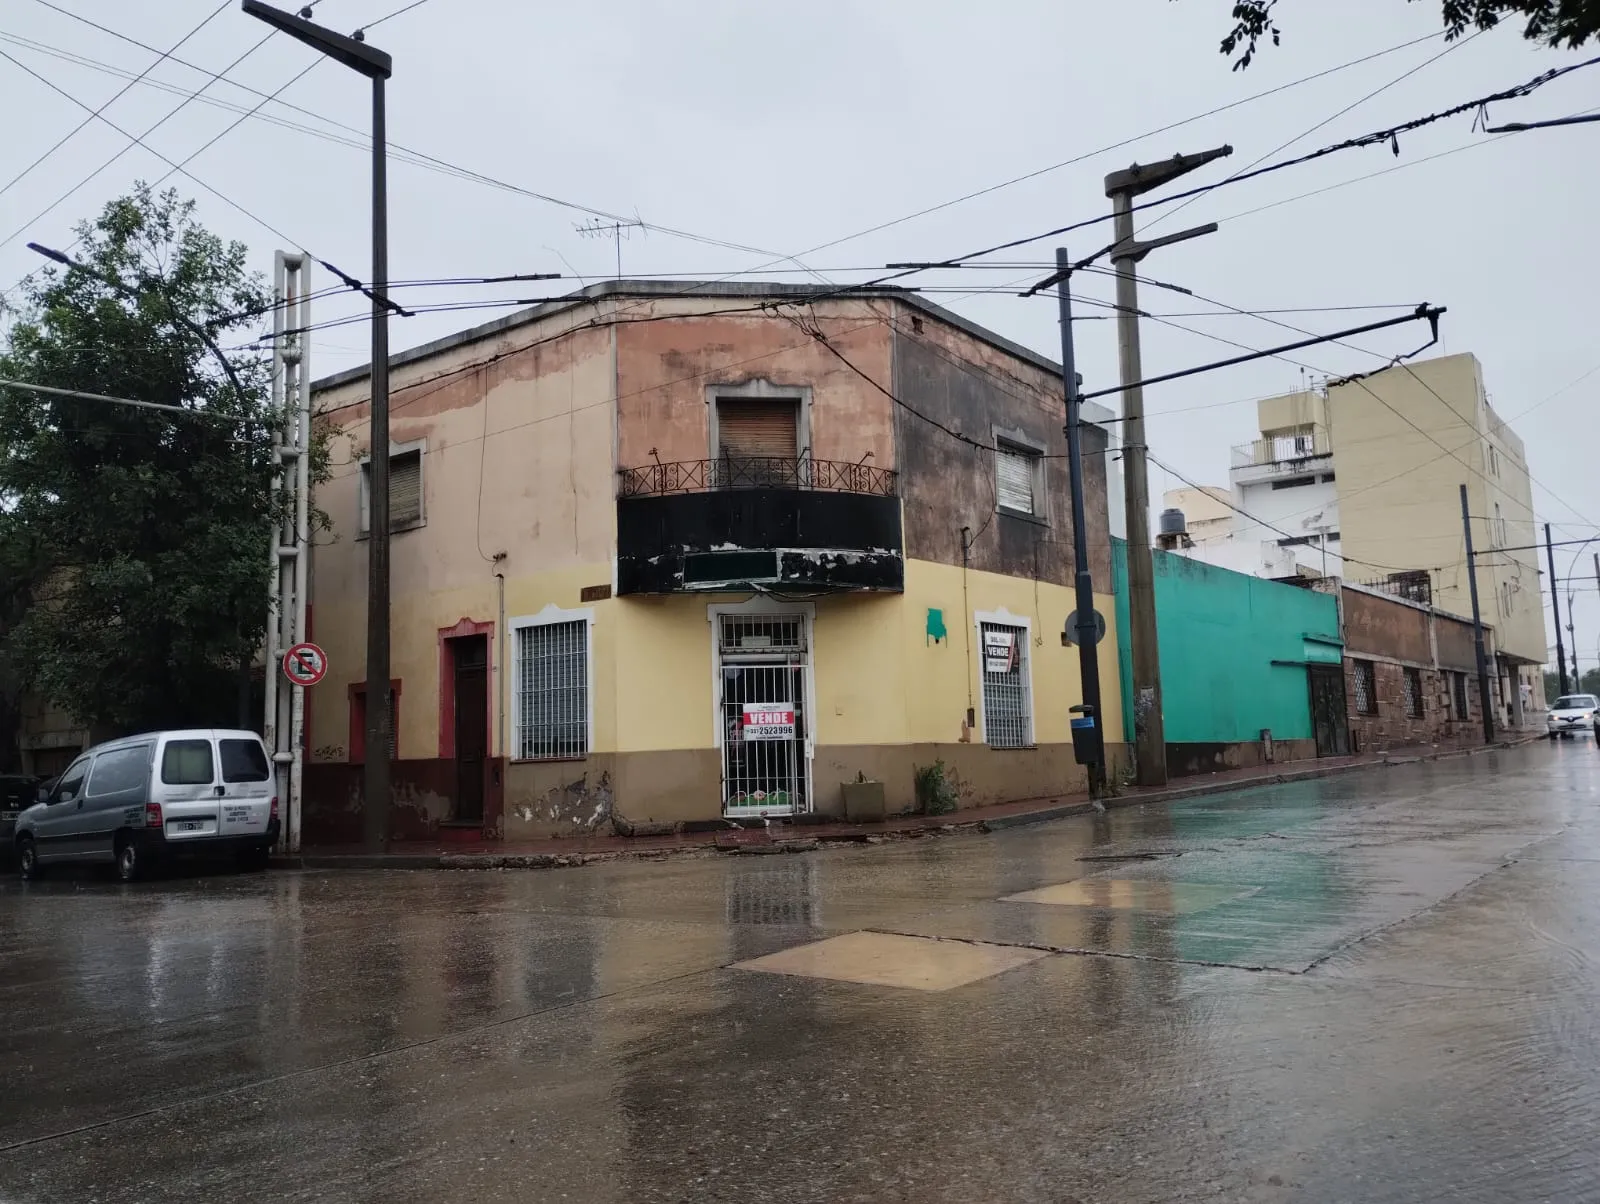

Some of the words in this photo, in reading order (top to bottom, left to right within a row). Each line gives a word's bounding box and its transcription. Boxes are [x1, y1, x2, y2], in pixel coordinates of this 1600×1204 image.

[987, 647, 1009, 656] VENDE
[750, 712, 788, 724] VENDE
[760, 726, 793, 734] 2523996
